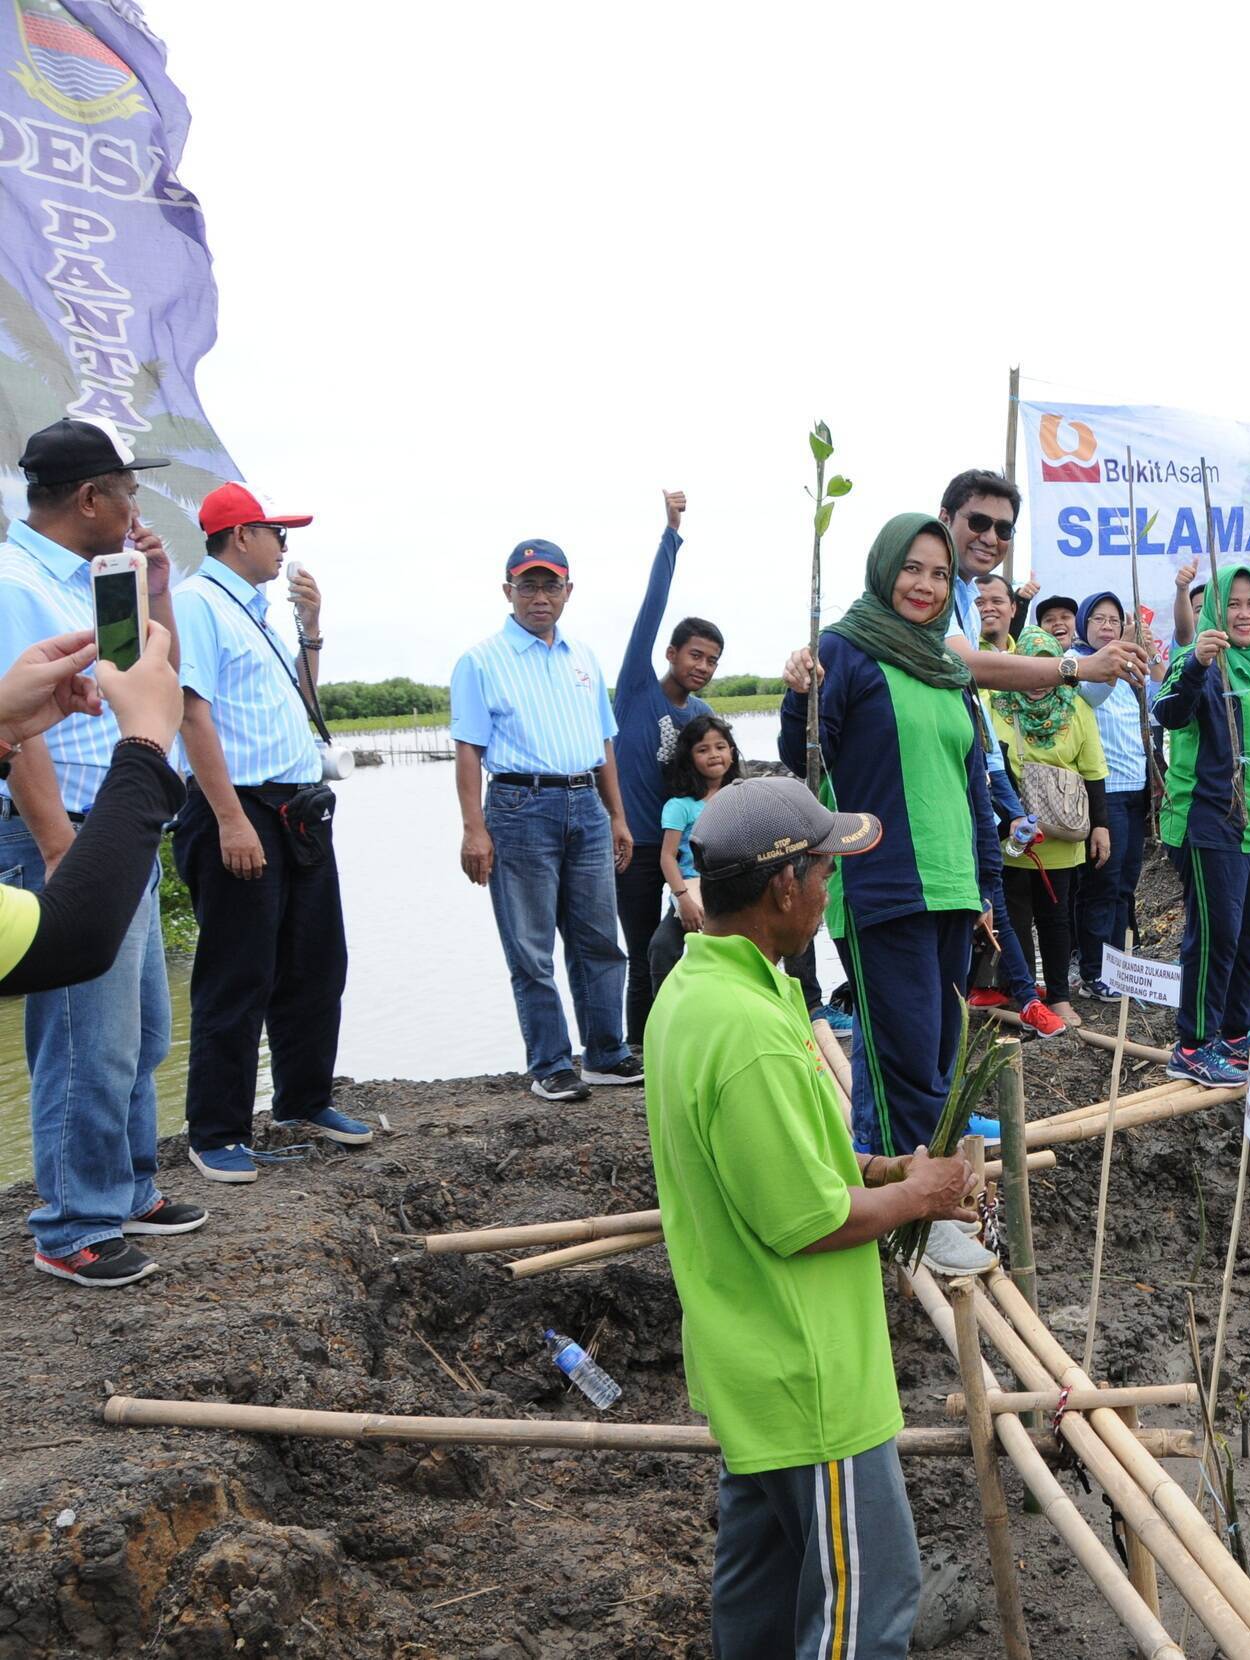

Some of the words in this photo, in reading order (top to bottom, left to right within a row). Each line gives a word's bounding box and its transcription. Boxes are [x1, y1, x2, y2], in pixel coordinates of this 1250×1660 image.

[41, 198, 152, 447] PANTA
[773, 837, 791, 849] STOP
[757, 849, 785, 861] ILLEGAL
